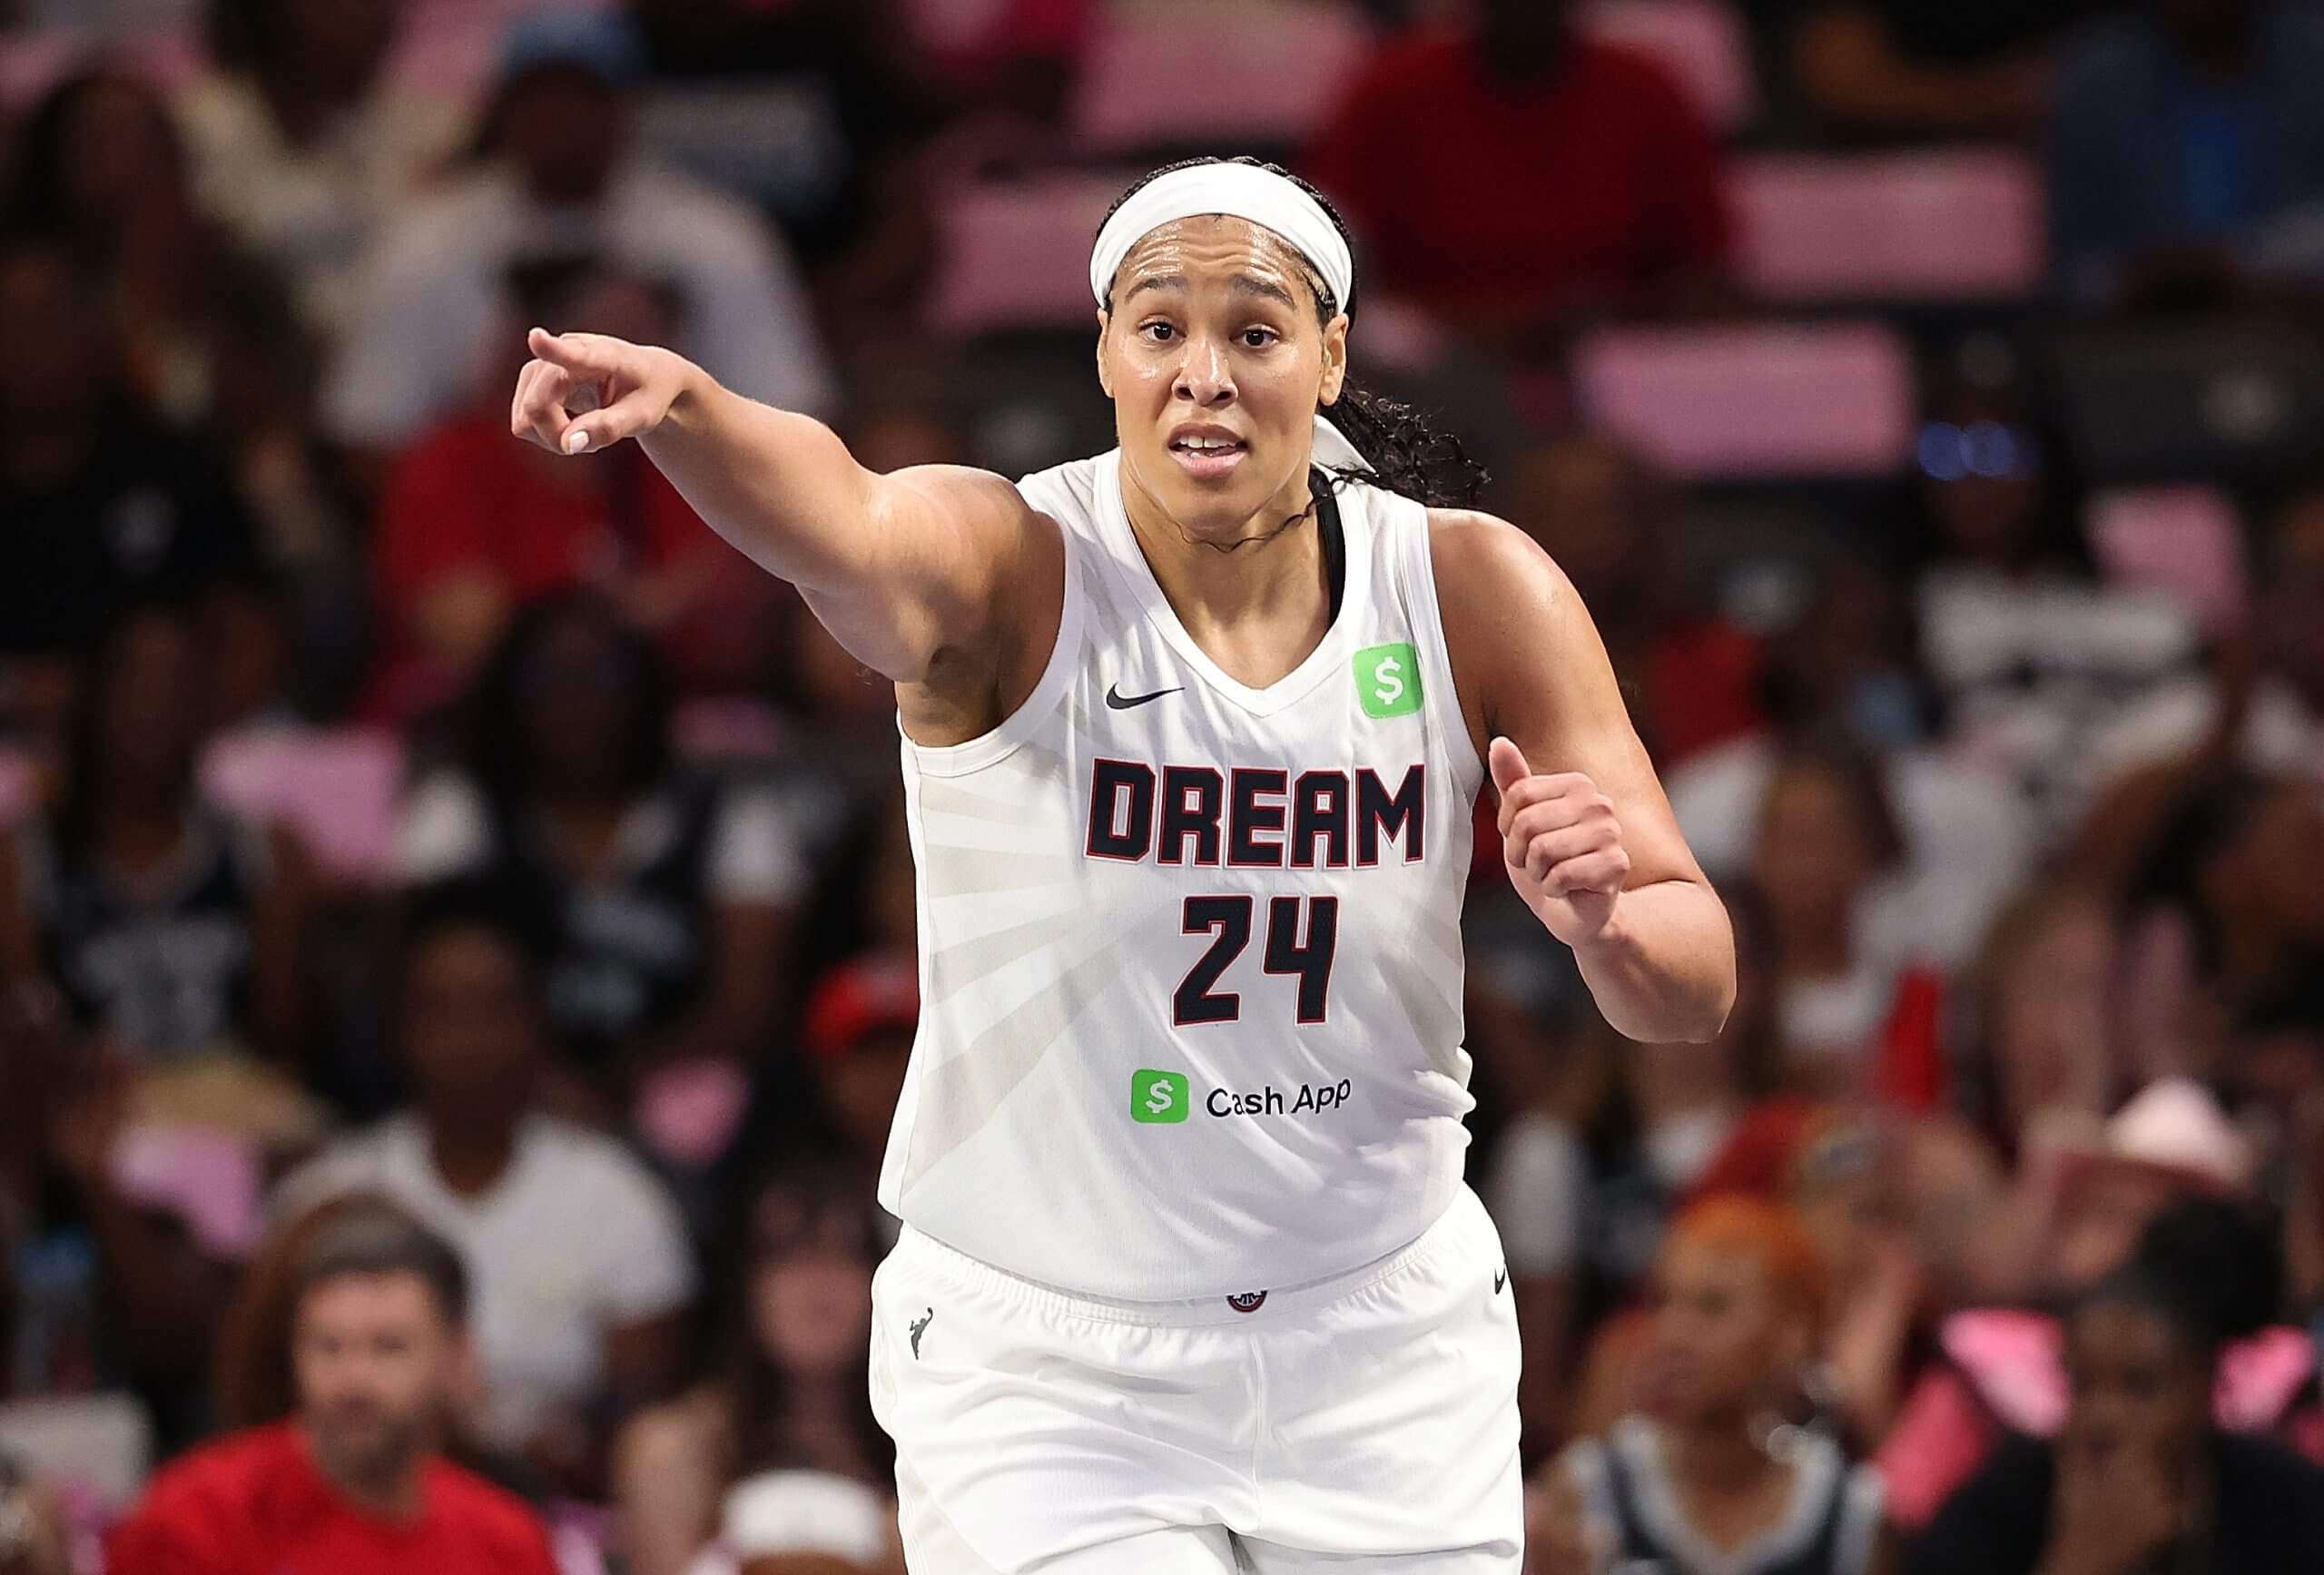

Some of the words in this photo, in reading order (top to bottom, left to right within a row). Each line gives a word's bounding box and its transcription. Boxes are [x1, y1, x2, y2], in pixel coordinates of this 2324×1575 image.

[1374, 656, 1405, 704] $
[1086, 758, 1425, 869] DREAM
[1173, 895, 1338, 1026] 24
[1206, 1088, 1284, 1117] Cash
[1291, 1078, 1351, 1115] App
